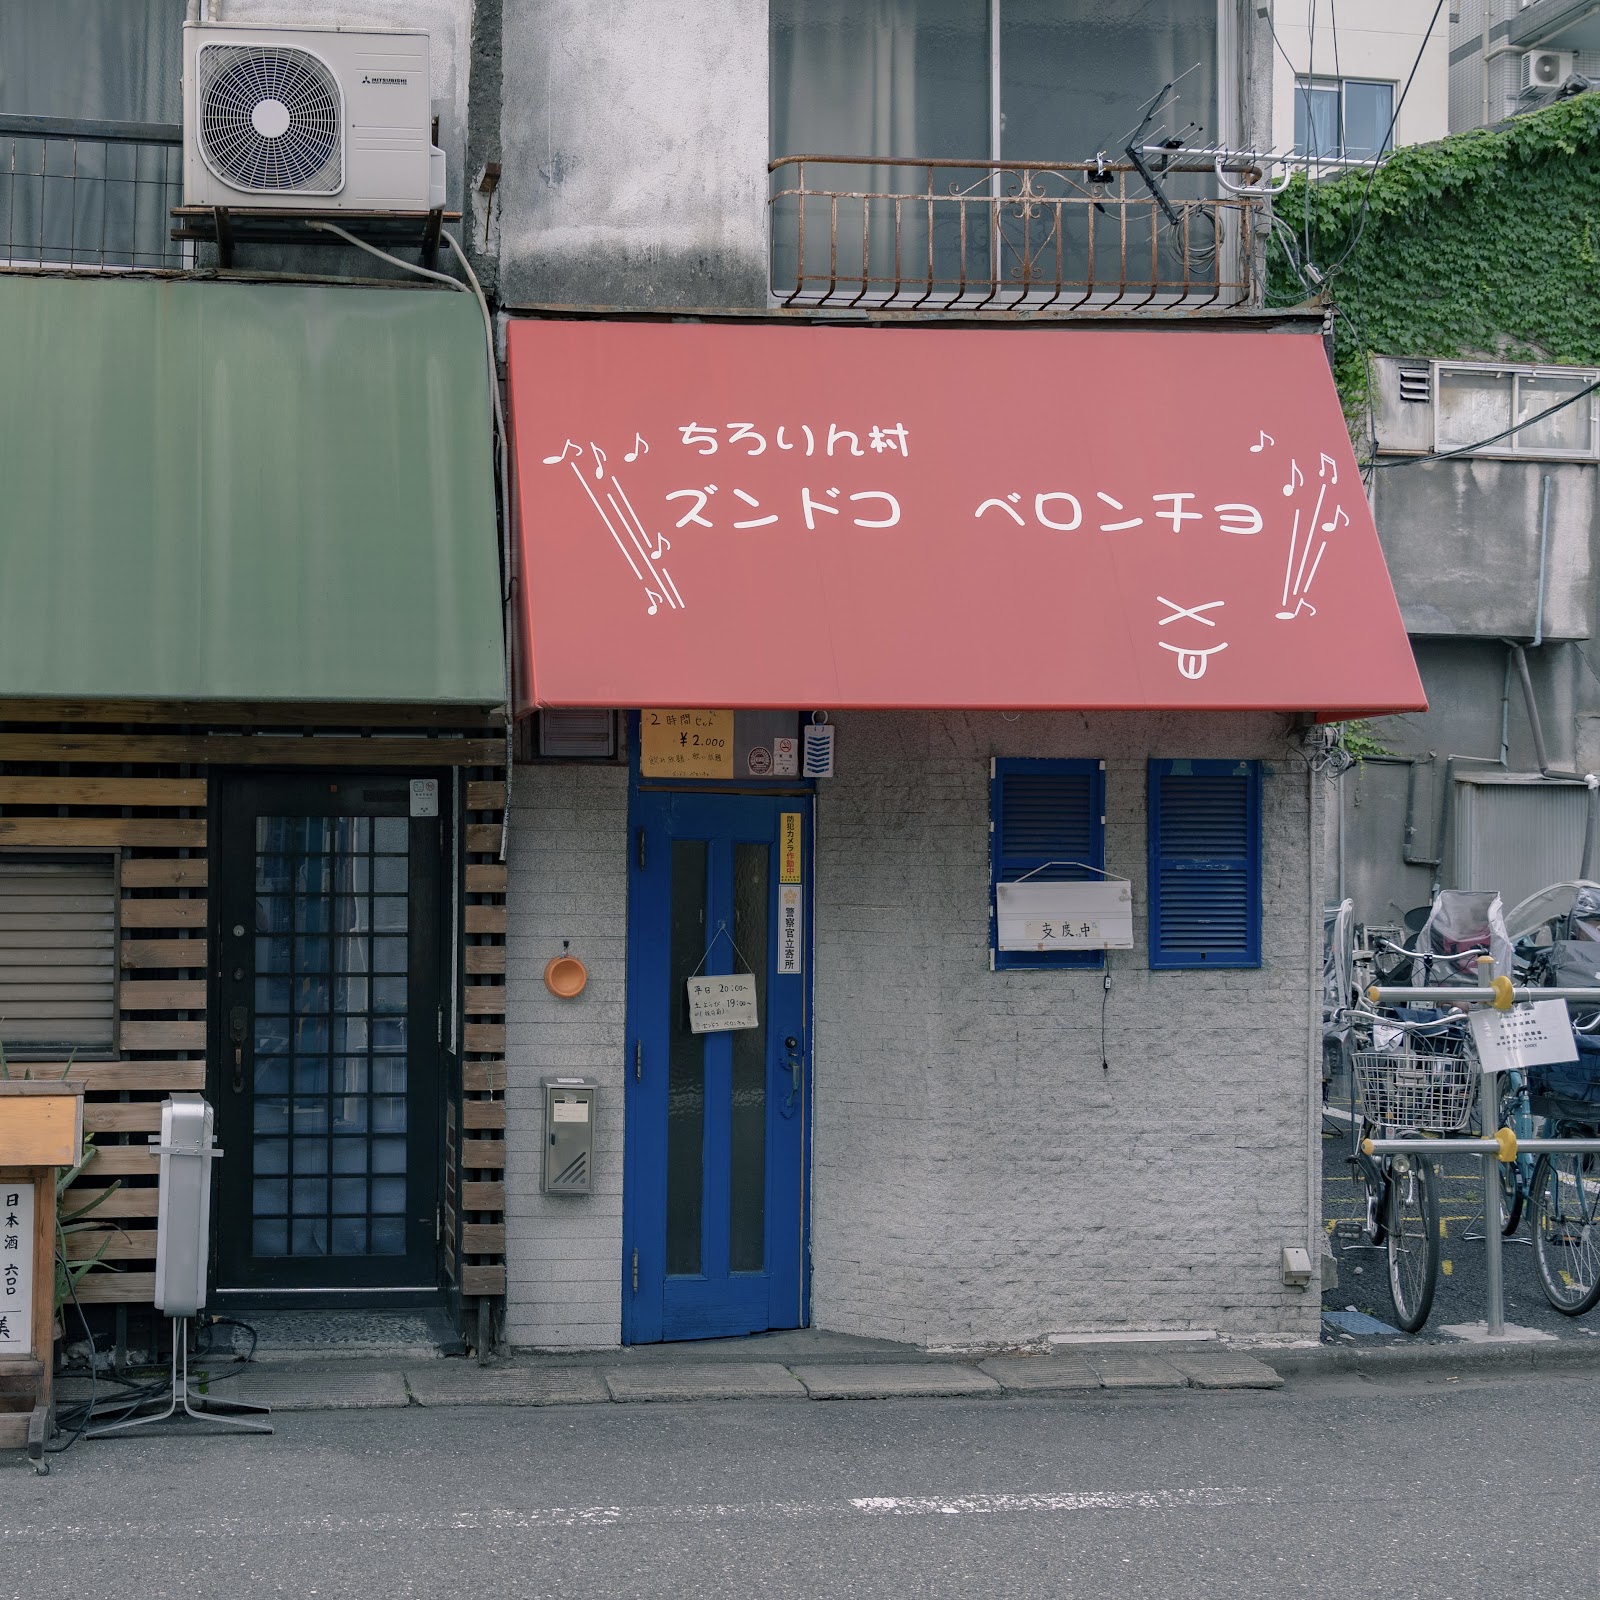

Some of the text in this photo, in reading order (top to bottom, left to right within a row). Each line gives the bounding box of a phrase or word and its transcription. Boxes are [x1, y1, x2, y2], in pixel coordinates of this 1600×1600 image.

[678, 421, 910, 458] ちろりん村
[665, 483, 901, 530] ズンドコ
[786, 815, 795, 875] 防犯カメラ作動中
[784, 907, 795, 970] 警察官立寄所
[1041, 921, 1090, 940] 支度中
[693, 985, 711, 996] 平日
[4, 1193, 20, 1250] 日本酒
